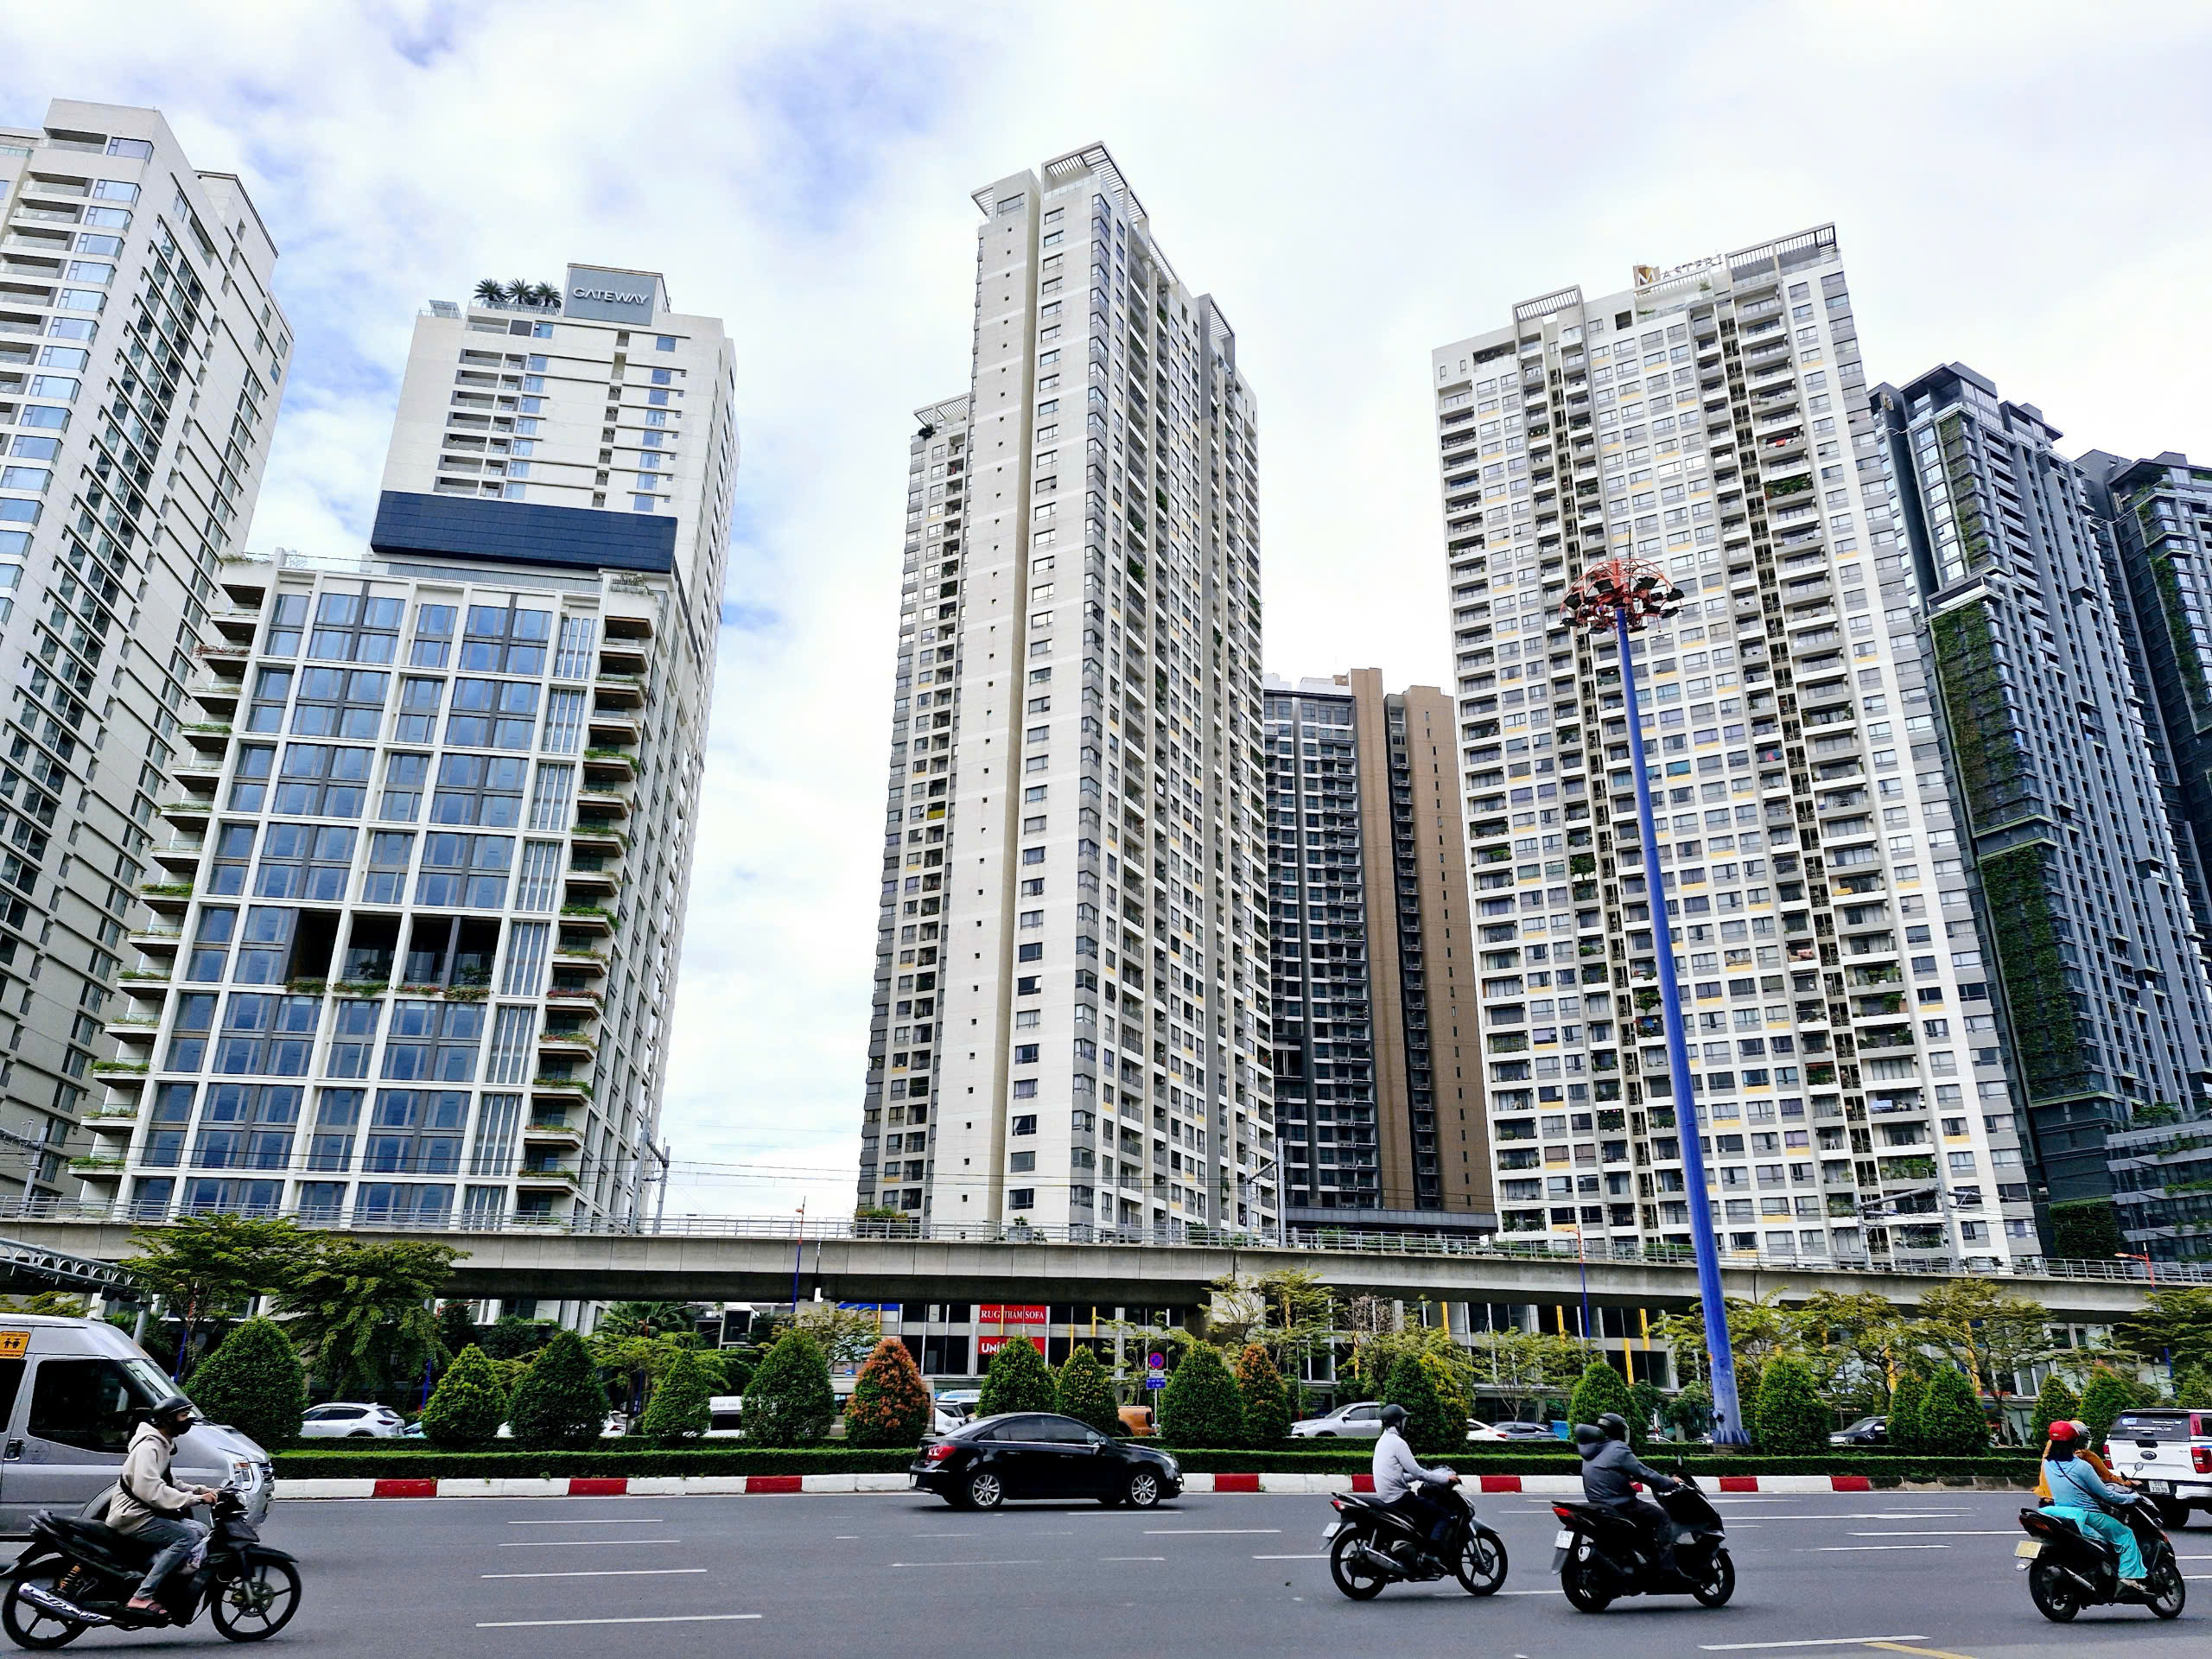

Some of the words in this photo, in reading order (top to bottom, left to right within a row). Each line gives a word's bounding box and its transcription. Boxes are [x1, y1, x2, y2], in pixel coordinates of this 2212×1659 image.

[573, 287, 649, 305] GATEWAY
[981, 1310, 1001, 1319] RUG
[1025, 1311, 1044, 1319] SOFA
